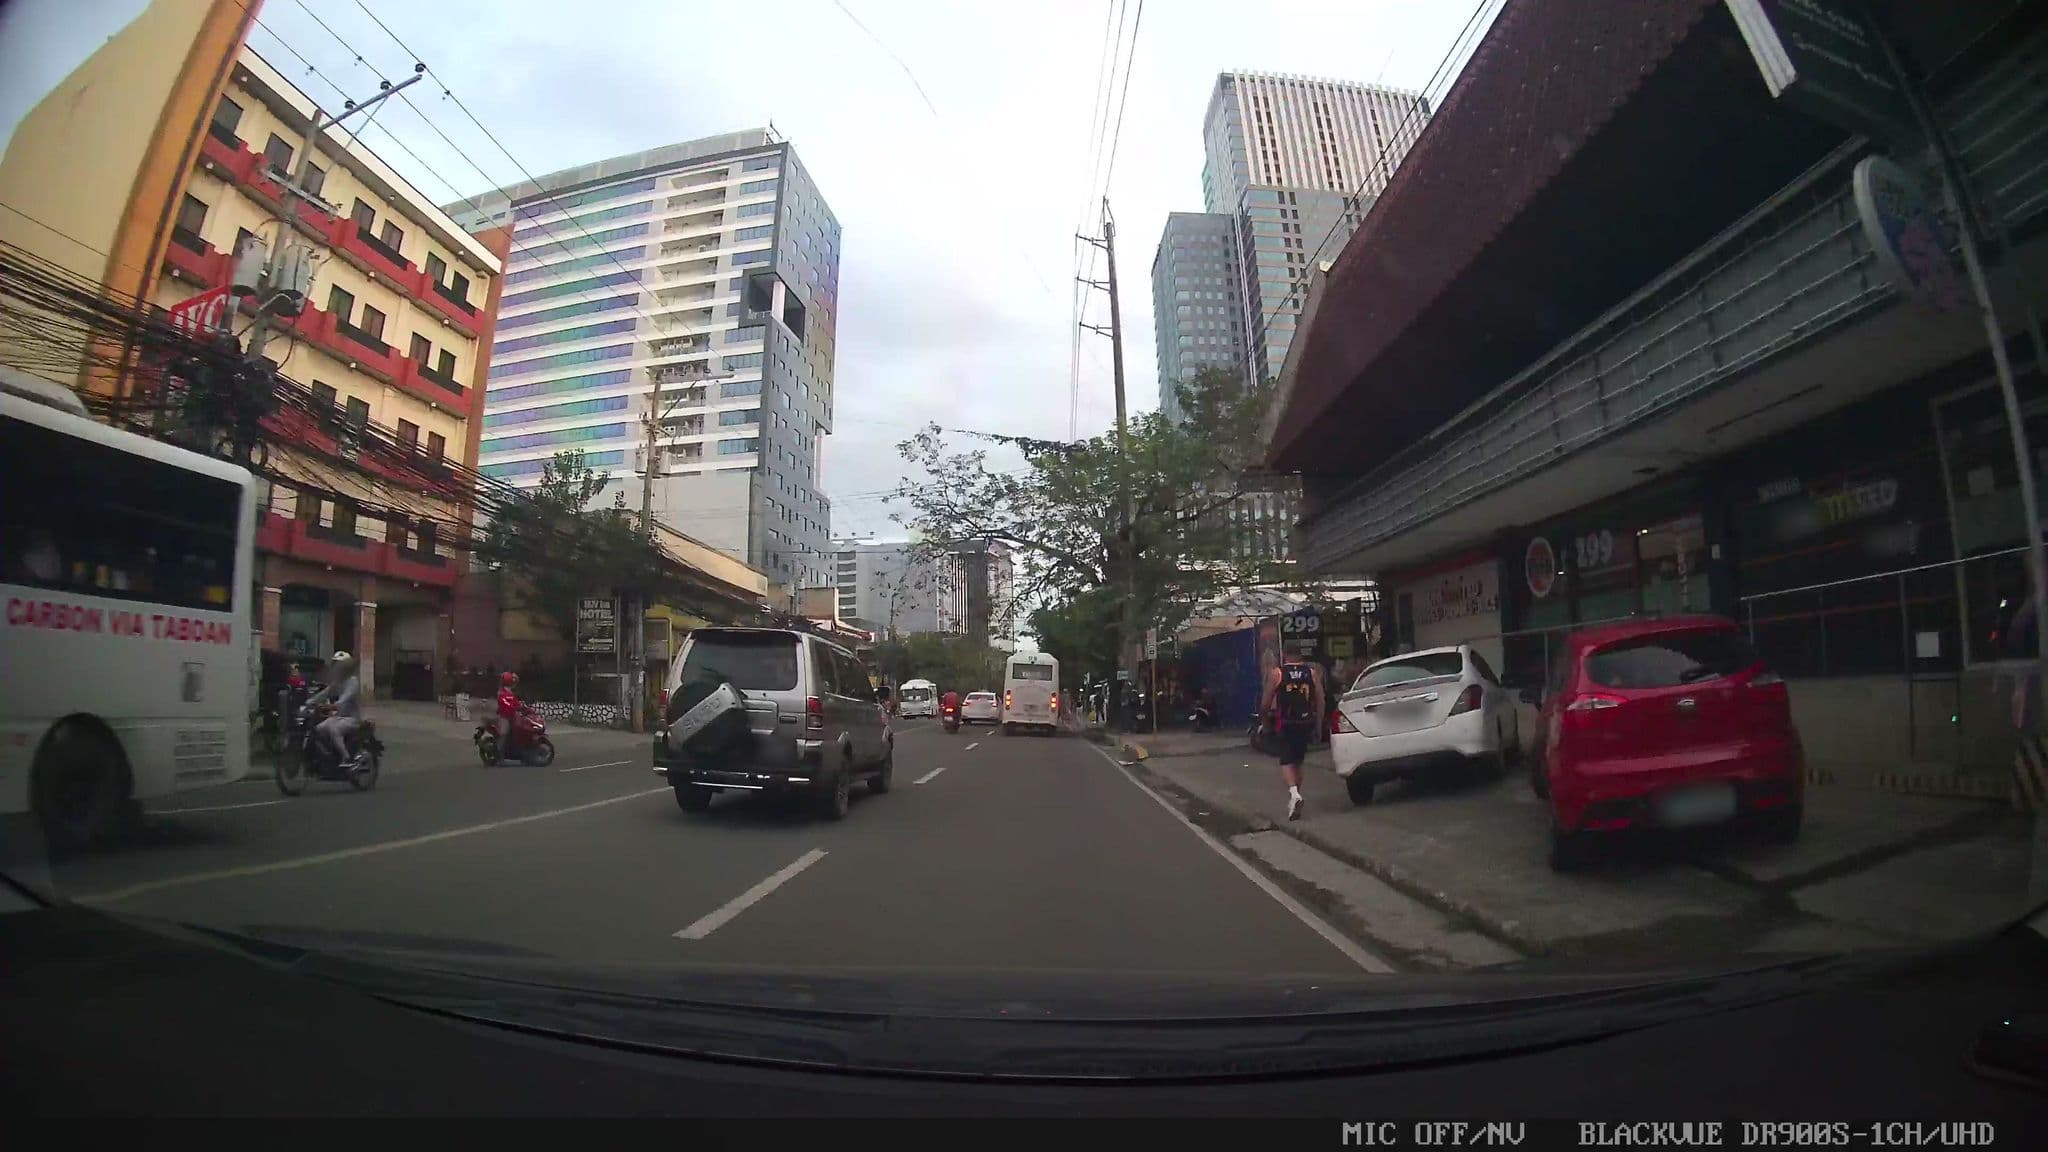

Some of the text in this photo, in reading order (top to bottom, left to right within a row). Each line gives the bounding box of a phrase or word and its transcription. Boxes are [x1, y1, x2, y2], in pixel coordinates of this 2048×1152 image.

[6, 597, 104, 633] CARBON
[108, 610, 145, 636] VIA
[579, 608, 611, 619] HOTEL
[1283, 616, 1320, 633] 299
